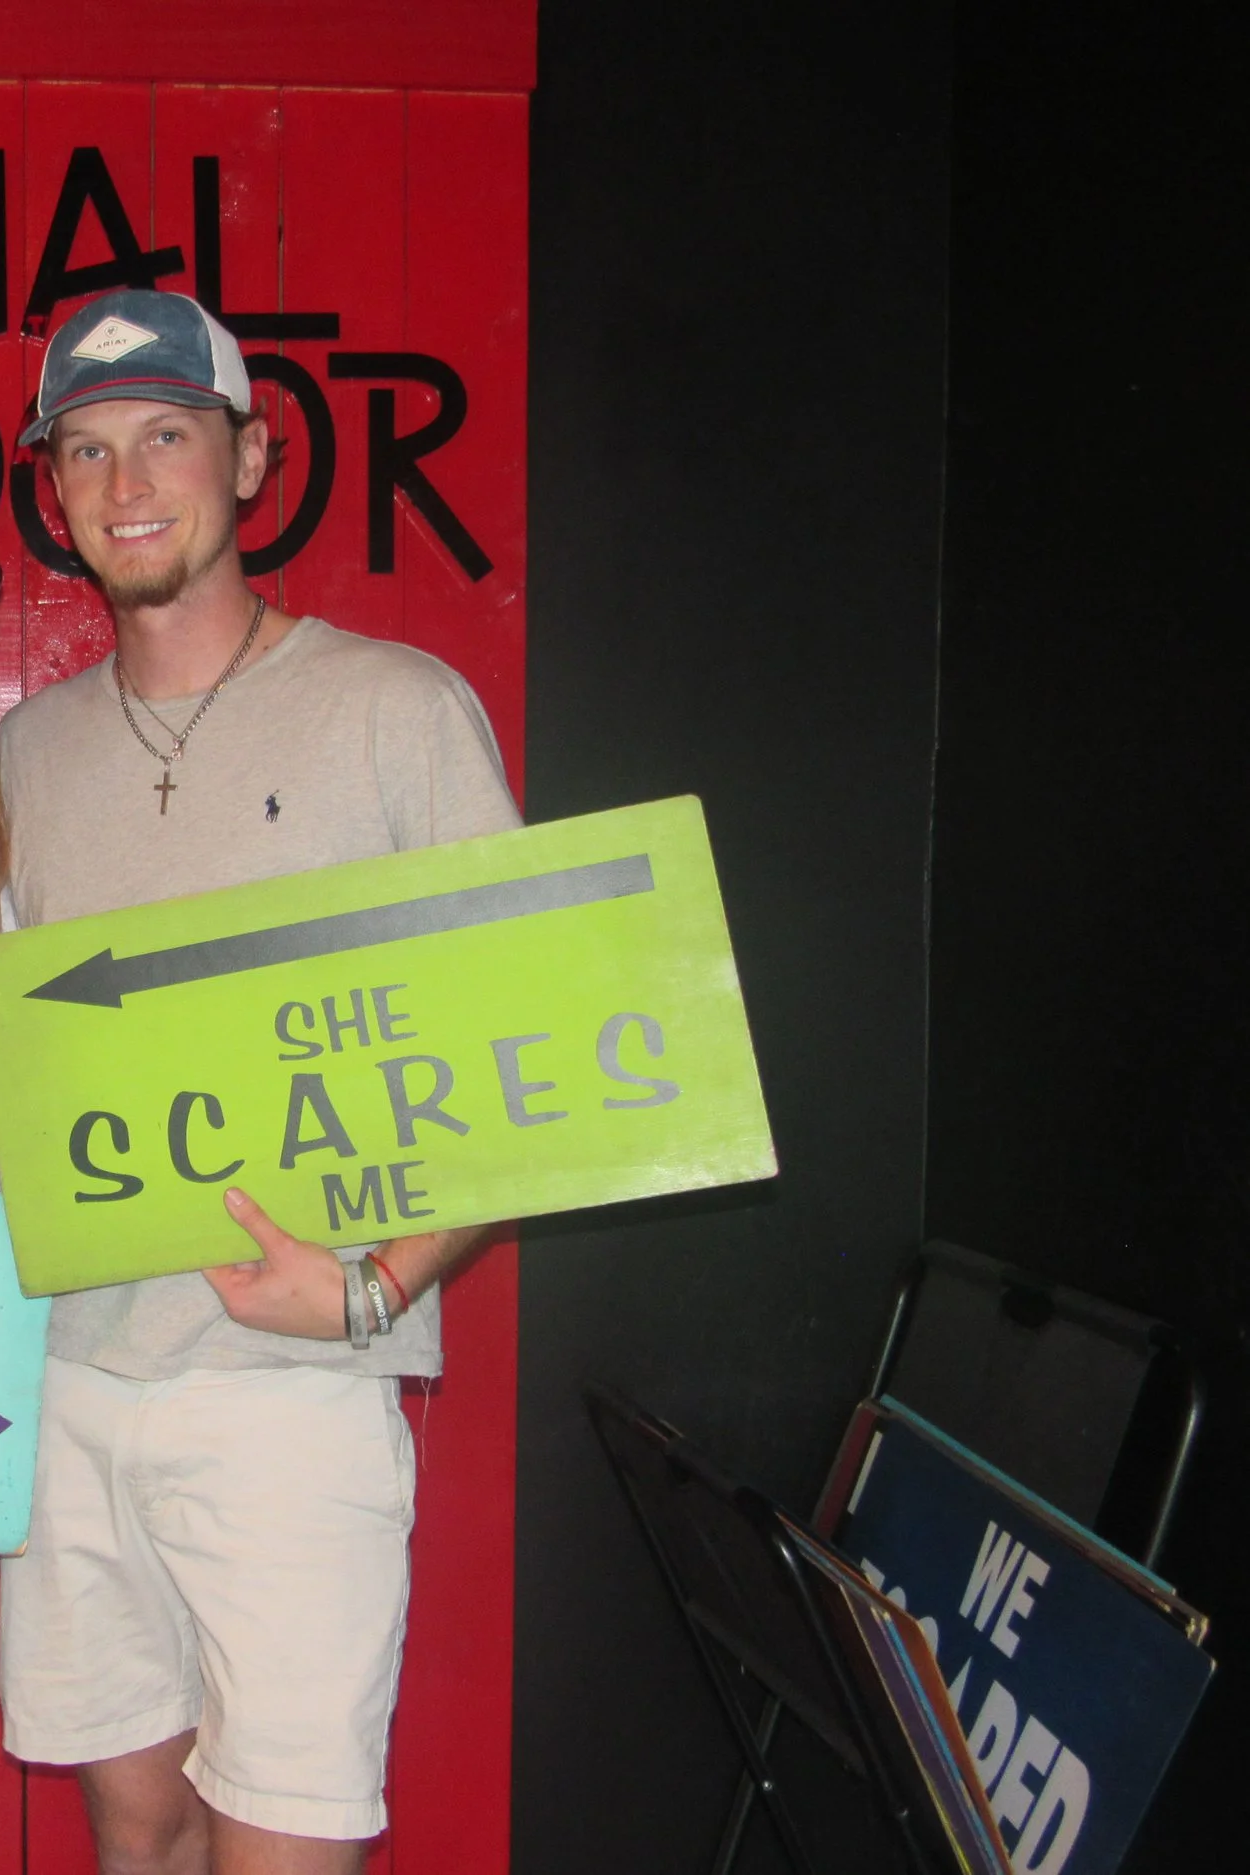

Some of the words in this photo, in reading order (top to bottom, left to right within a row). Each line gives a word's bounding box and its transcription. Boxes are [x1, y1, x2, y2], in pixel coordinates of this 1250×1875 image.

[95, 338, 128, 350] ARIAT
[275, 983, 418, 1061] SHE
[69, 1011, 683, 1203] SCARES
[321, 1160, 438, 1232] ME
[373, 1294, 386, 1317] WHO
[959, 1520, 1050, 1659] WE
